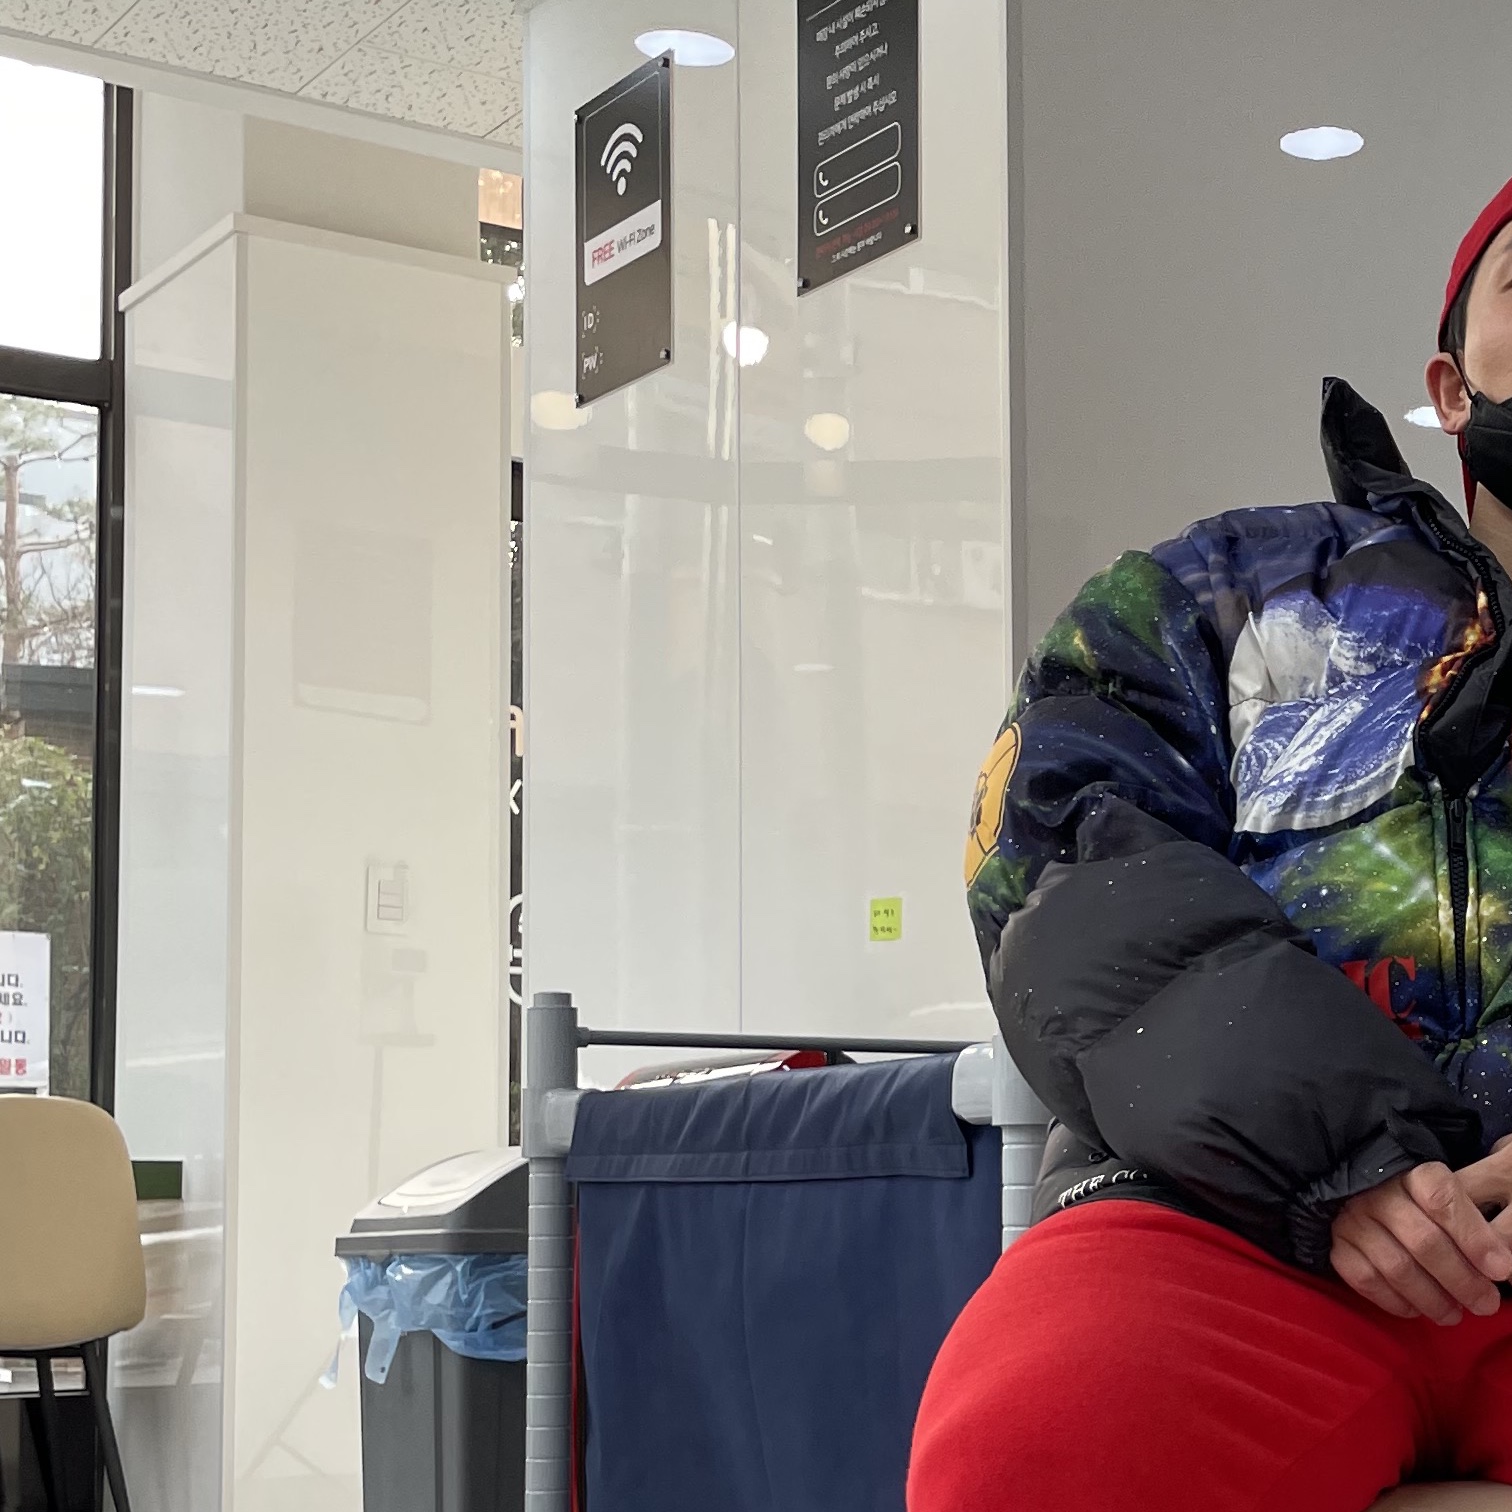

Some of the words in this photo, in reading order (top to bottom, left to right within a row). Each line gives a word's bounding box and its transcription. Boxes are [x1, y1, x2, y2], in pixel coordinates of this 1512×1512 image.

[592, 239, 615, 269] FREE
[636, 223, 655, 244] Zone
[583, 312, 595, 331] ID
[583, 353, 598, 374] PW
